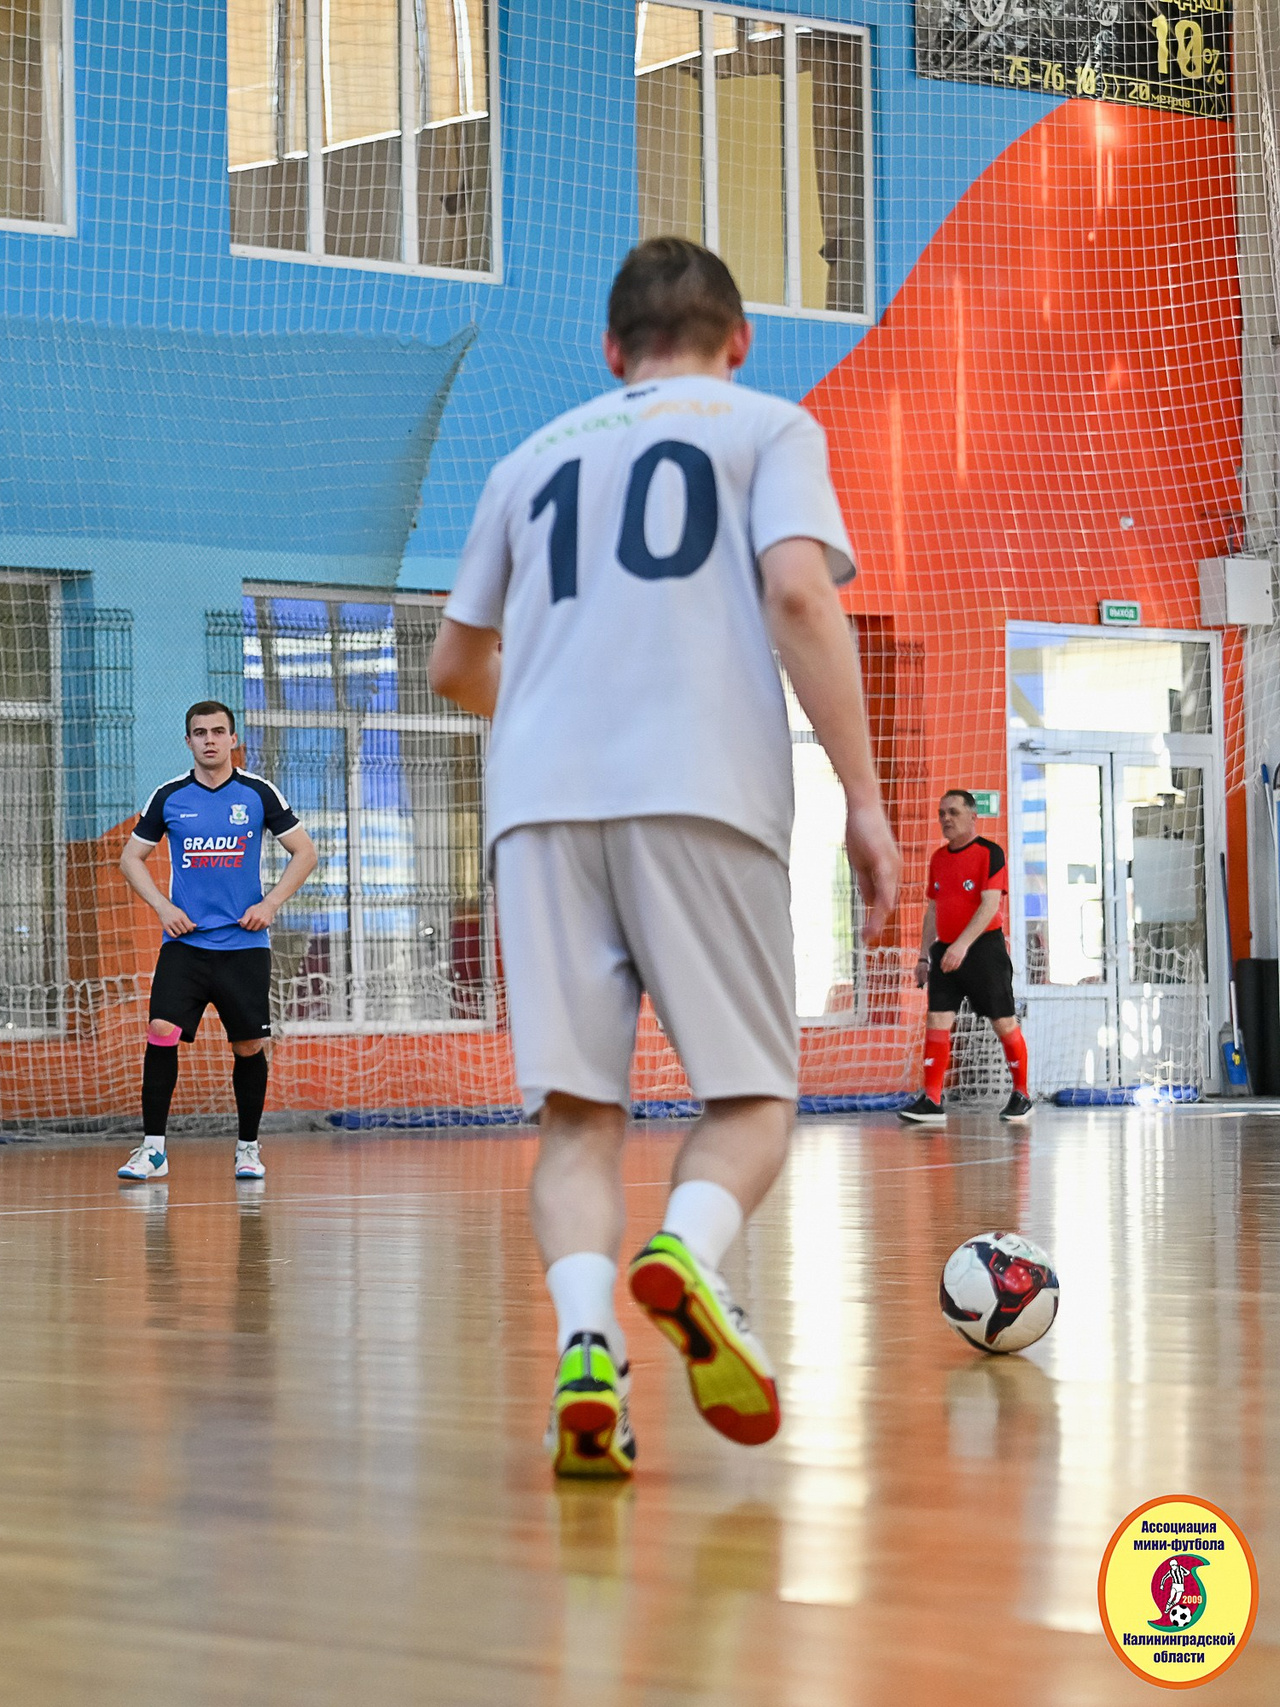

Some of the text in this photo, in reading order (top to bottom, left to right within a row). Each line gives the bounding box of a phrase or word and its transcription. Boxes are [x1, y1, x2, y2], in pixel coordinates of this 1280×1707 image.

[1152, 13, 1225, 85] 10%
[1004, 55, 1096, 95] 75-76-10
[1128, 82, 1150, 100] 20
[529, 438, 719, 606] 10
[181, 851, 244, 869] SERVICE
